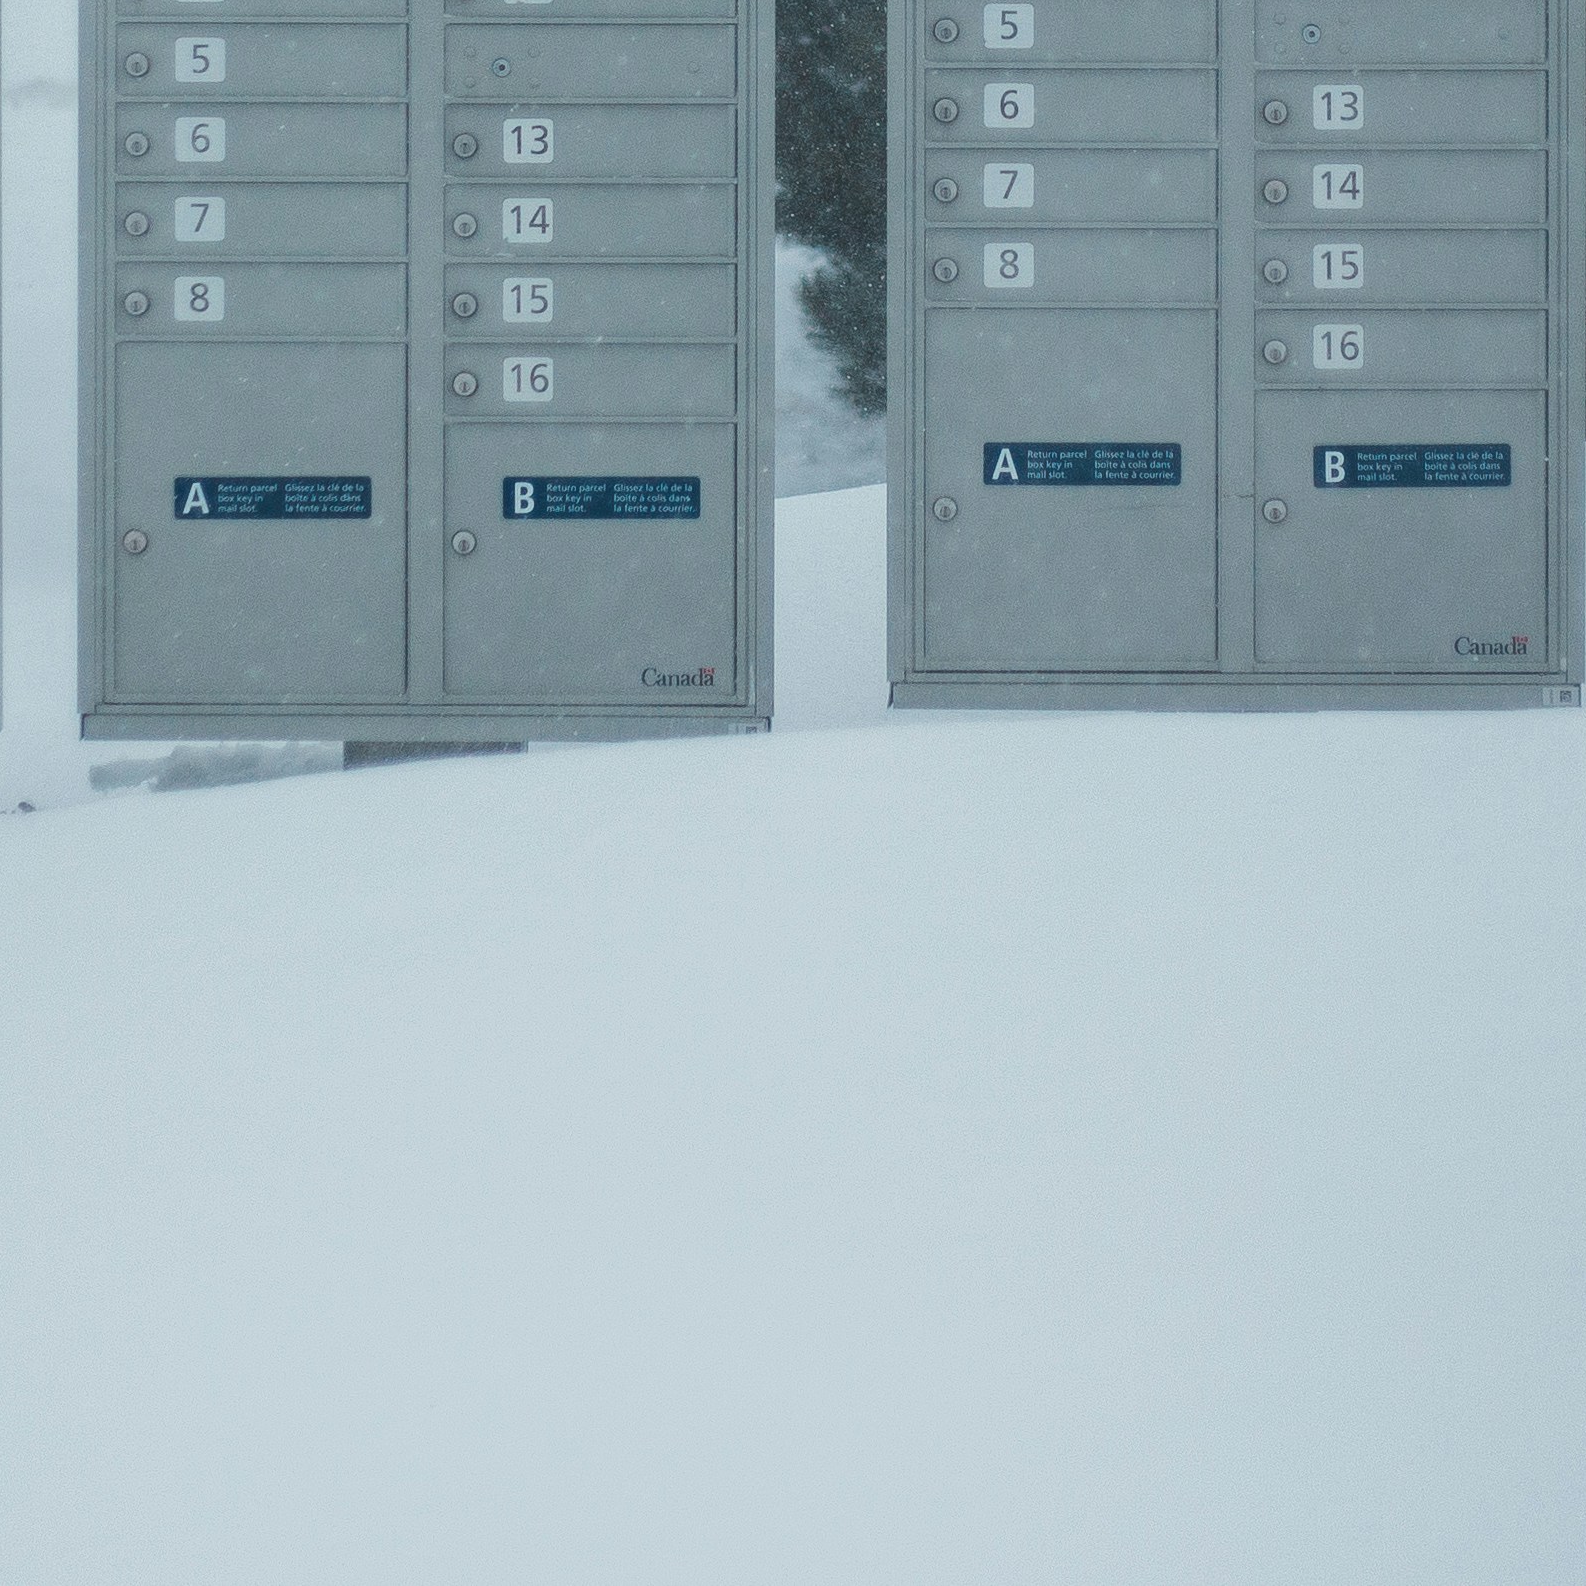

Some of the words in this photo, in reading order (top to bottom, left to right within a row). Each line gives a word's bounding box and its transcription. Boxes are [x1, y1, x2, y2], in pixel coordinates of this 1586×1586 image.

[1000, 10, 1019, 40] 5
[192, 43, 210, 74] 5
[999, 89, 1019, 120] 6
[1321, 91, 1359, 122] 13
[191, 122, 211, 154] 6
[511, 124, 549, 155] 13
[999, 169, 1019, 200] 7
[1321, 170, 1361, 201] 14
[190, 203, 210, 233] 7
[510, 204, 550, 235] 14
[999, 248, 1020, 280] 8
[1321, 250, 1359, 281] 15
[189, 282, 210, 313] 8
[510, 284, 549, 315] 15
[1321, 330, 1360, 361] 16
[510, 362, 550, 394] 16
[992, 448, 1018, 480] A
[1325, 451, 1346, 483] B
[182, 482, 210, 514] A
[514, 481, 535, 514] B
[1454, 636, 1528, 655] Canada
[641, 667, 715, 687] Canada
